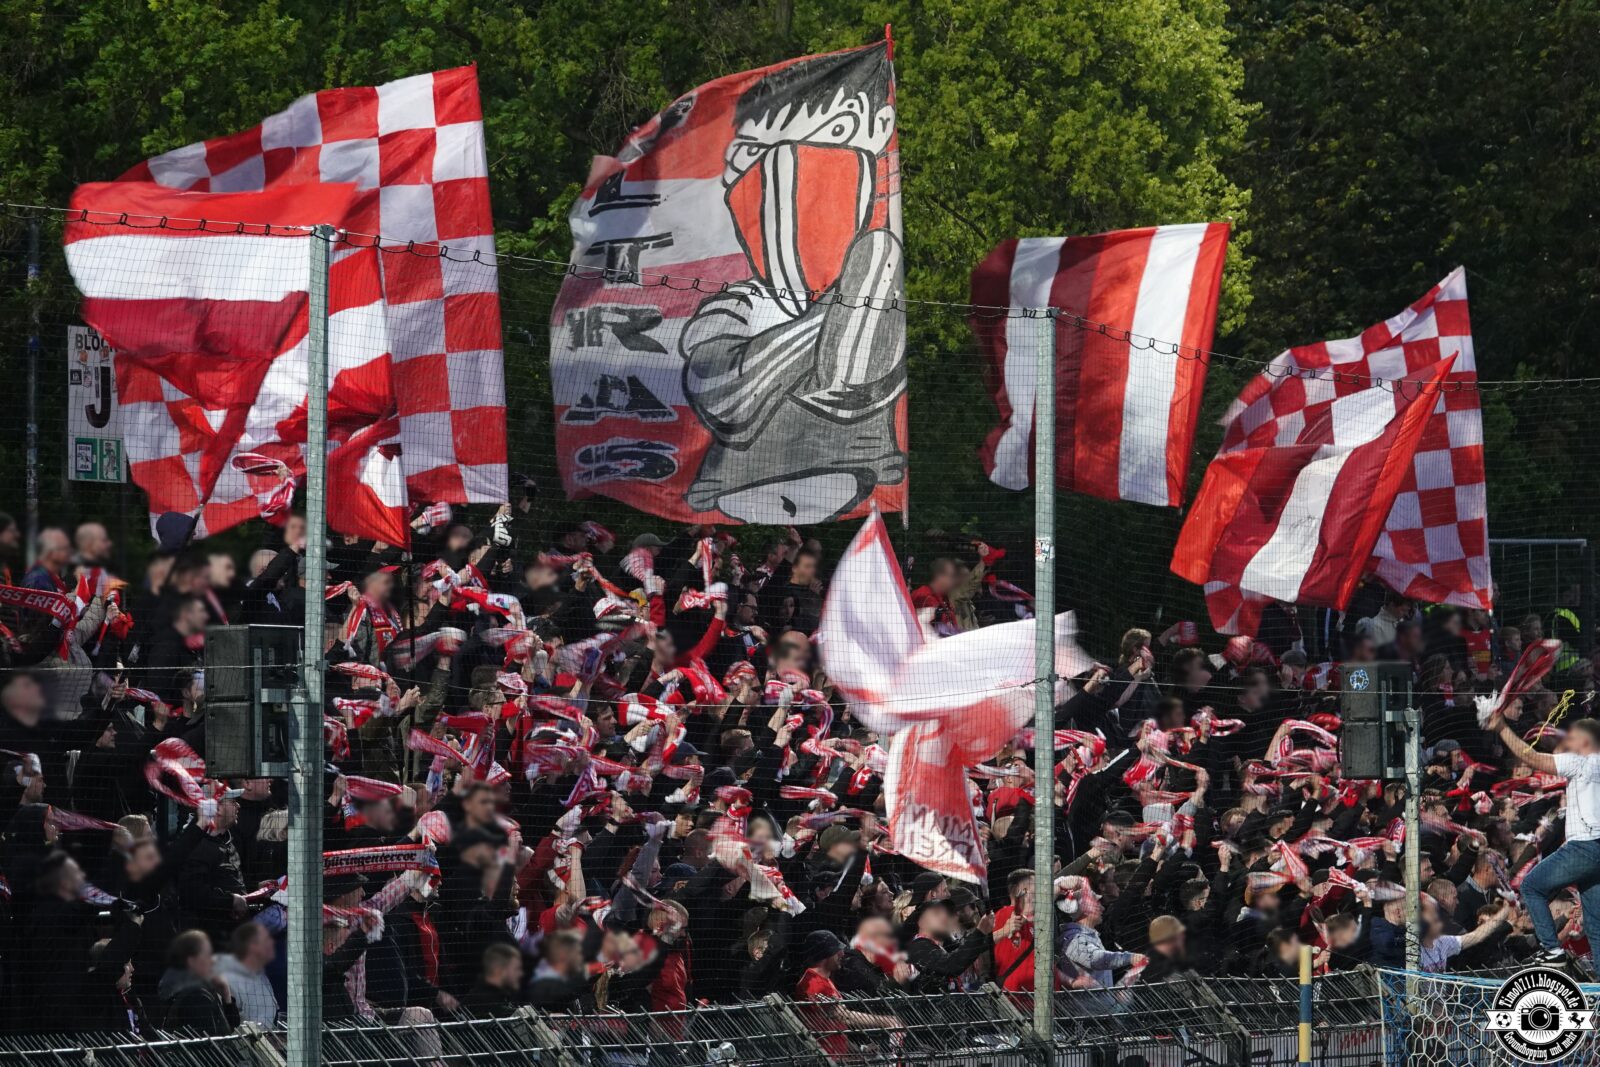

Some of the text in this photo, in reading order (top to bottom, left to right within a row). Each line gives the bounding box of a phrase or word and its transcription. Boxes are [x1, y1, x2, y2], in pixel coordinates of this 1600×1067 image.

[75, 333, 118, 352] BLOC
[85, 366, 111, 428] J
[323, 852, 417, 868] hüringenterror
